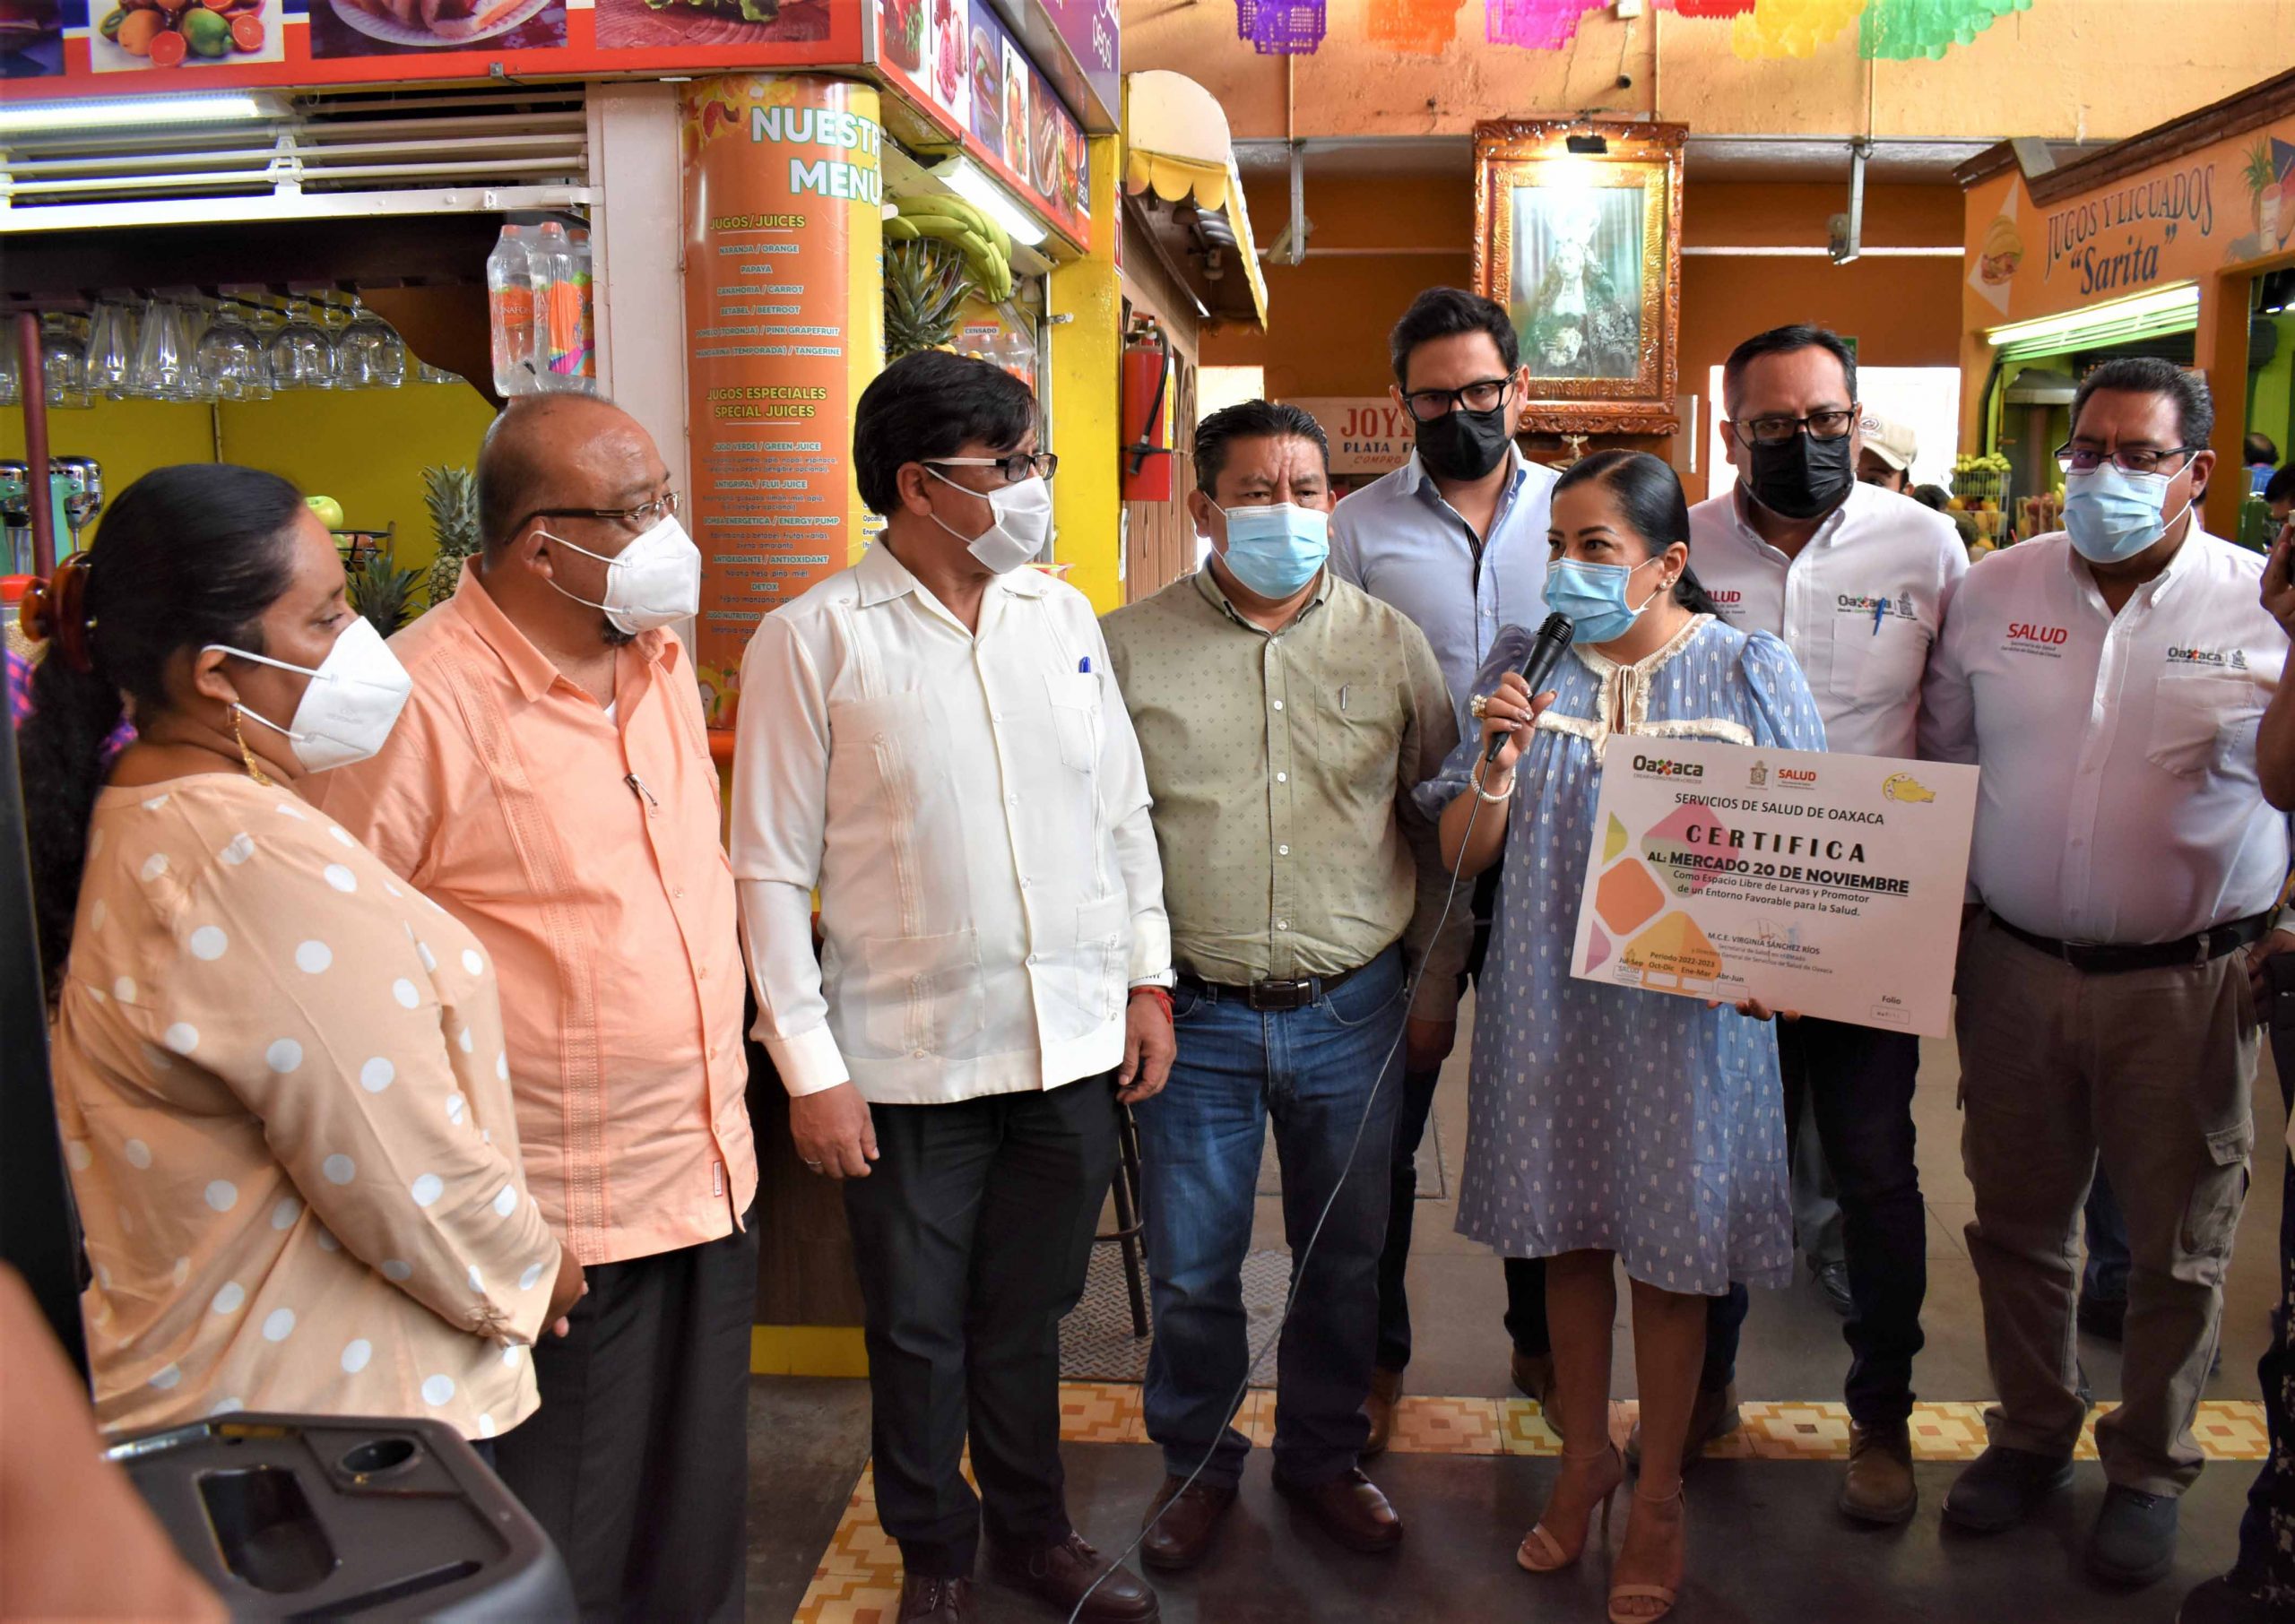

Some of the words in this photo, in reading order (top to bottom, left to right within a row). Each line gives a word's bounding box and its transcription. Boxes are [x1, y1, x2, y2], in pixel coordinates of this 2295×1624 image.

[1093, 13, 1112, 72] pepsi
[2044, 201, 2099, 285] JUGOS
[2104, 194, 2115, 229] Y
[2117, 164, 2216, 237] LICUADOS
[719, 246, 754, 255] NARANJA
[762, 244, 799, 254] ORANGE
[740, 264, 773, 274] PAPAYA
[767, 285, 803, 295] CARROT
[757, 305, 801, 315] BEETROOT
[766, 326, 787, 335] PINK
[788, 326, 840, 337] GRAPEFRUIT
[964, 326, 999, 334] CENSADO
[794, 346, 842, 357] TANGERINE
[706, 388, 744, 402] JUGOS
[746, 386, 827, 401] ESPECIALES
[714, 404, 762, 419] SPECIAL
[765, 404, 816, 418] JUICES
[1340, 408, 1413, 437] JOY
[732, 442, 757, 452] VERDE
[764, 442, 793, 452] GREEN
[795, 442, 821, 451] JUICE
[1344, 442, 1390, 453] PLATA
[1354, 455, 1402, 464] COMPRO
[782, 479, 808, 489] JUICE
[778, 516, 813, 525] ENERGY
[814, 516, 840, 525] PUMP
[769, 555, 829, 565] ANTIOXIDANT
[751, 583, 779, 592] DETOX
[1705, 590, 1741, 602] ALUD
[2006, 623, 2067, 644] SALUD
[2168, 647, 2222, 661] Oaxaca
[1632, 755, 1703, 777] Oaxaca
[1779, 768, 1816, 782] SALUD
[1675, 792, 1738, 809] SERVICIOS
[1742, 799, 1758, 811] DE
[1761, 801, 1804, 816] SALUD
[1807, 808, 1824, 819] DE
[1828, 809, 1884, 825] OAXACA
[1685, 824, 1866, 863] CERTIFICA
[1647, 851, 1666, 863] AL:
[1669, 851, 1750, 873] MERCADO
[1753, 862, 1775, 877] 20
[1780, 865, 1802, 880] DE
[1806, 868, 1910, 894] NOVIEMBRE
[1673, 869, 1700, 881] Como
[1702, 874, 1737, 886] Espacio
[1739, 878, 1762, 890] Libre
[1764, 882, 1777, 892] de
[1780, 884, 1810, 896] Larvas
[1813, 889, 1819, 898] y
[1821, 889, 1870, 903] Promotor
[1677, 884, 1689, 894] de
[1705, 887, 1743, 900] Entorno
[1745, 893, 1791, 907] Favorable
[1794, 900, 1815, 911] para
[1818, 903, 1827, 912] la
[1829, 904, 1860, 917] Salud.
[1708, 932, 1730, 942] M.C.E.
[1732, 936, 1765, 947] VIRGINIA
[1802, 945, 1821, 955] RÍOS
[1650, 952, 1677, 962] Periodo
[1678, 955, 1715, 968] 2022-2023
[1787, 962, 1802, 970] Salud
[1619, 956, 1643, 967] Jul-Sep
[1649, 962, 1675, 971] Oct-Dic
[1681, 966, 1711, 977] Ene-Mar
[1717, 972, 1745, 982] Abr-Jun
[1882, 995, 1901, 1005] Folio
